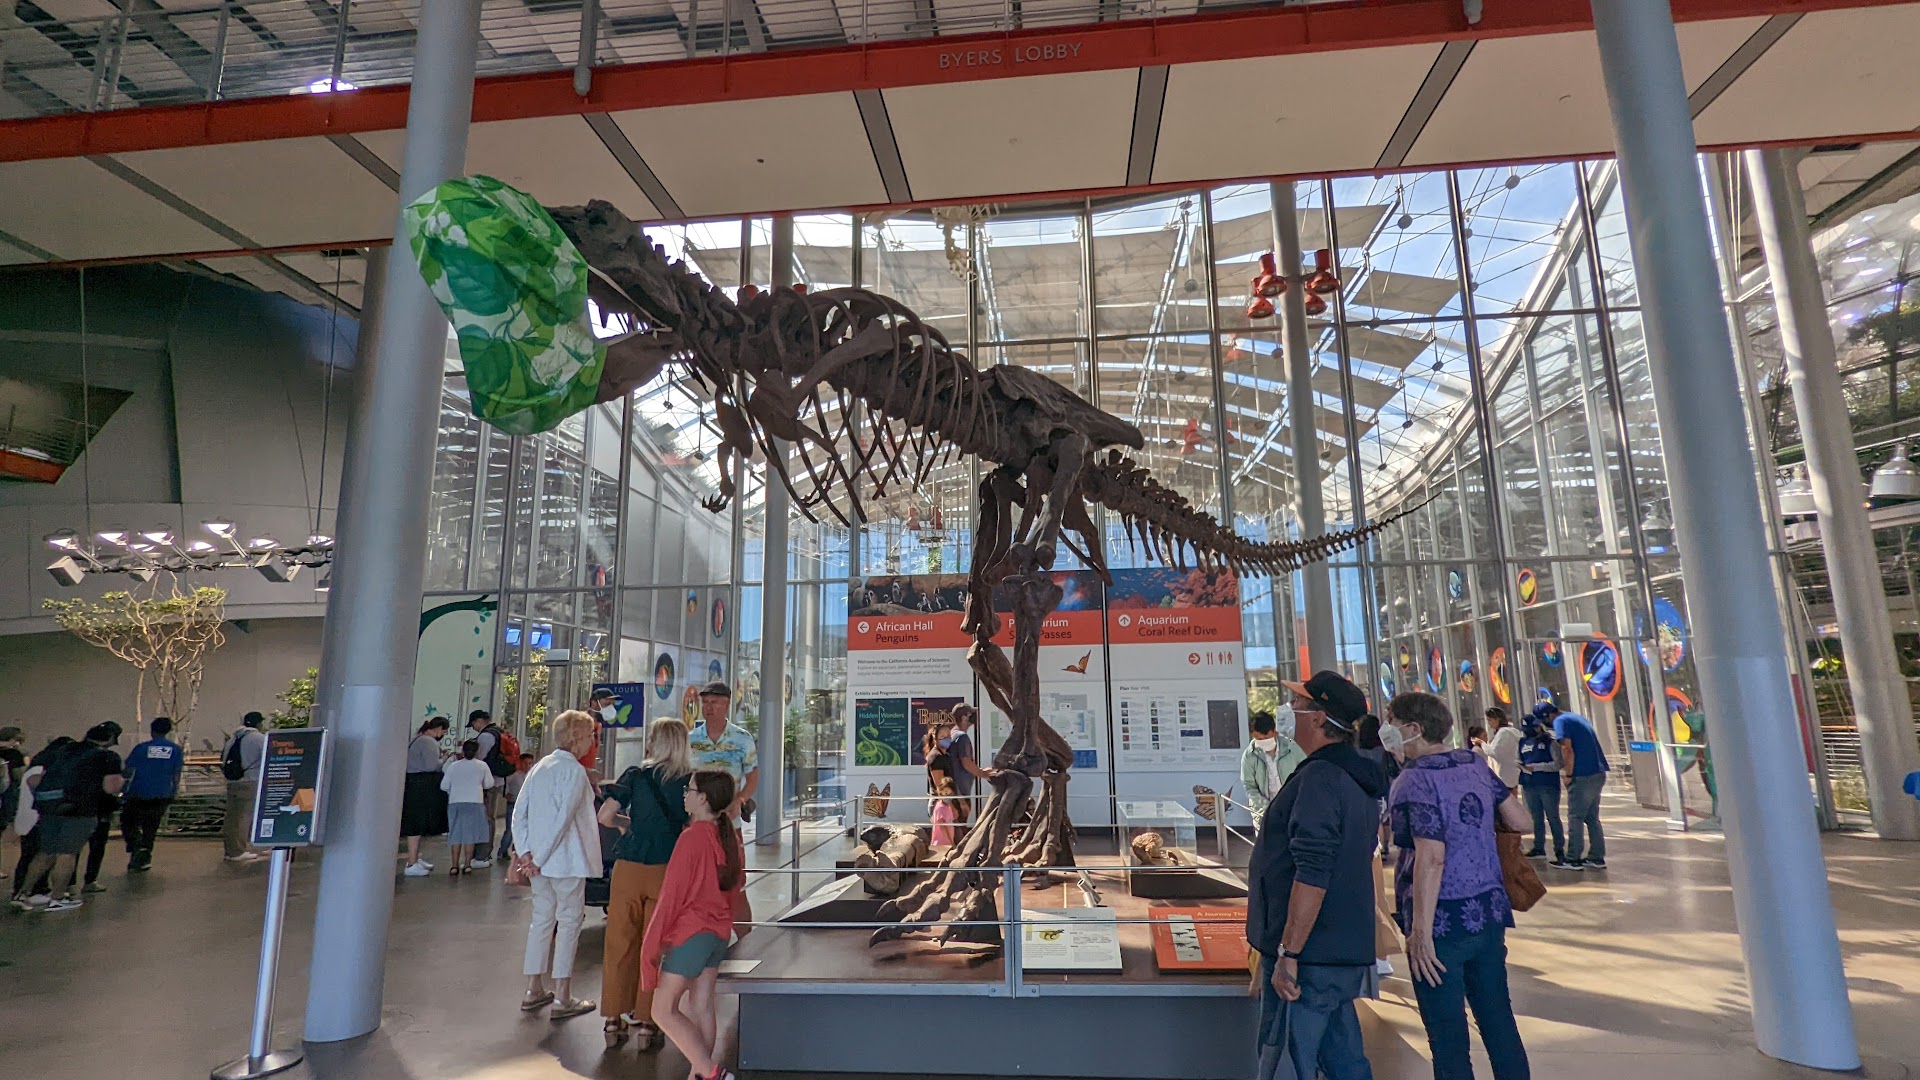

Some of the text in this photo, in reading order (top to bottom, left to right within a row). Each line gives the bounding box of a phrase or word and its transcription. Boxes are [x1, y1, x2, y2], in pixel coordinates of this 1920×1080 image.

[939, 42, 1082, 69] BYERS LOBBY
[875, 620, 933, 631] African Hall
[1138, 614, 1189, 627] Aquarium
[1138, 625, 1218, 637] Coral Reef Dive
[876, 633, 919, 644] Penguins
[614, 686, 640, 694] TOURS
